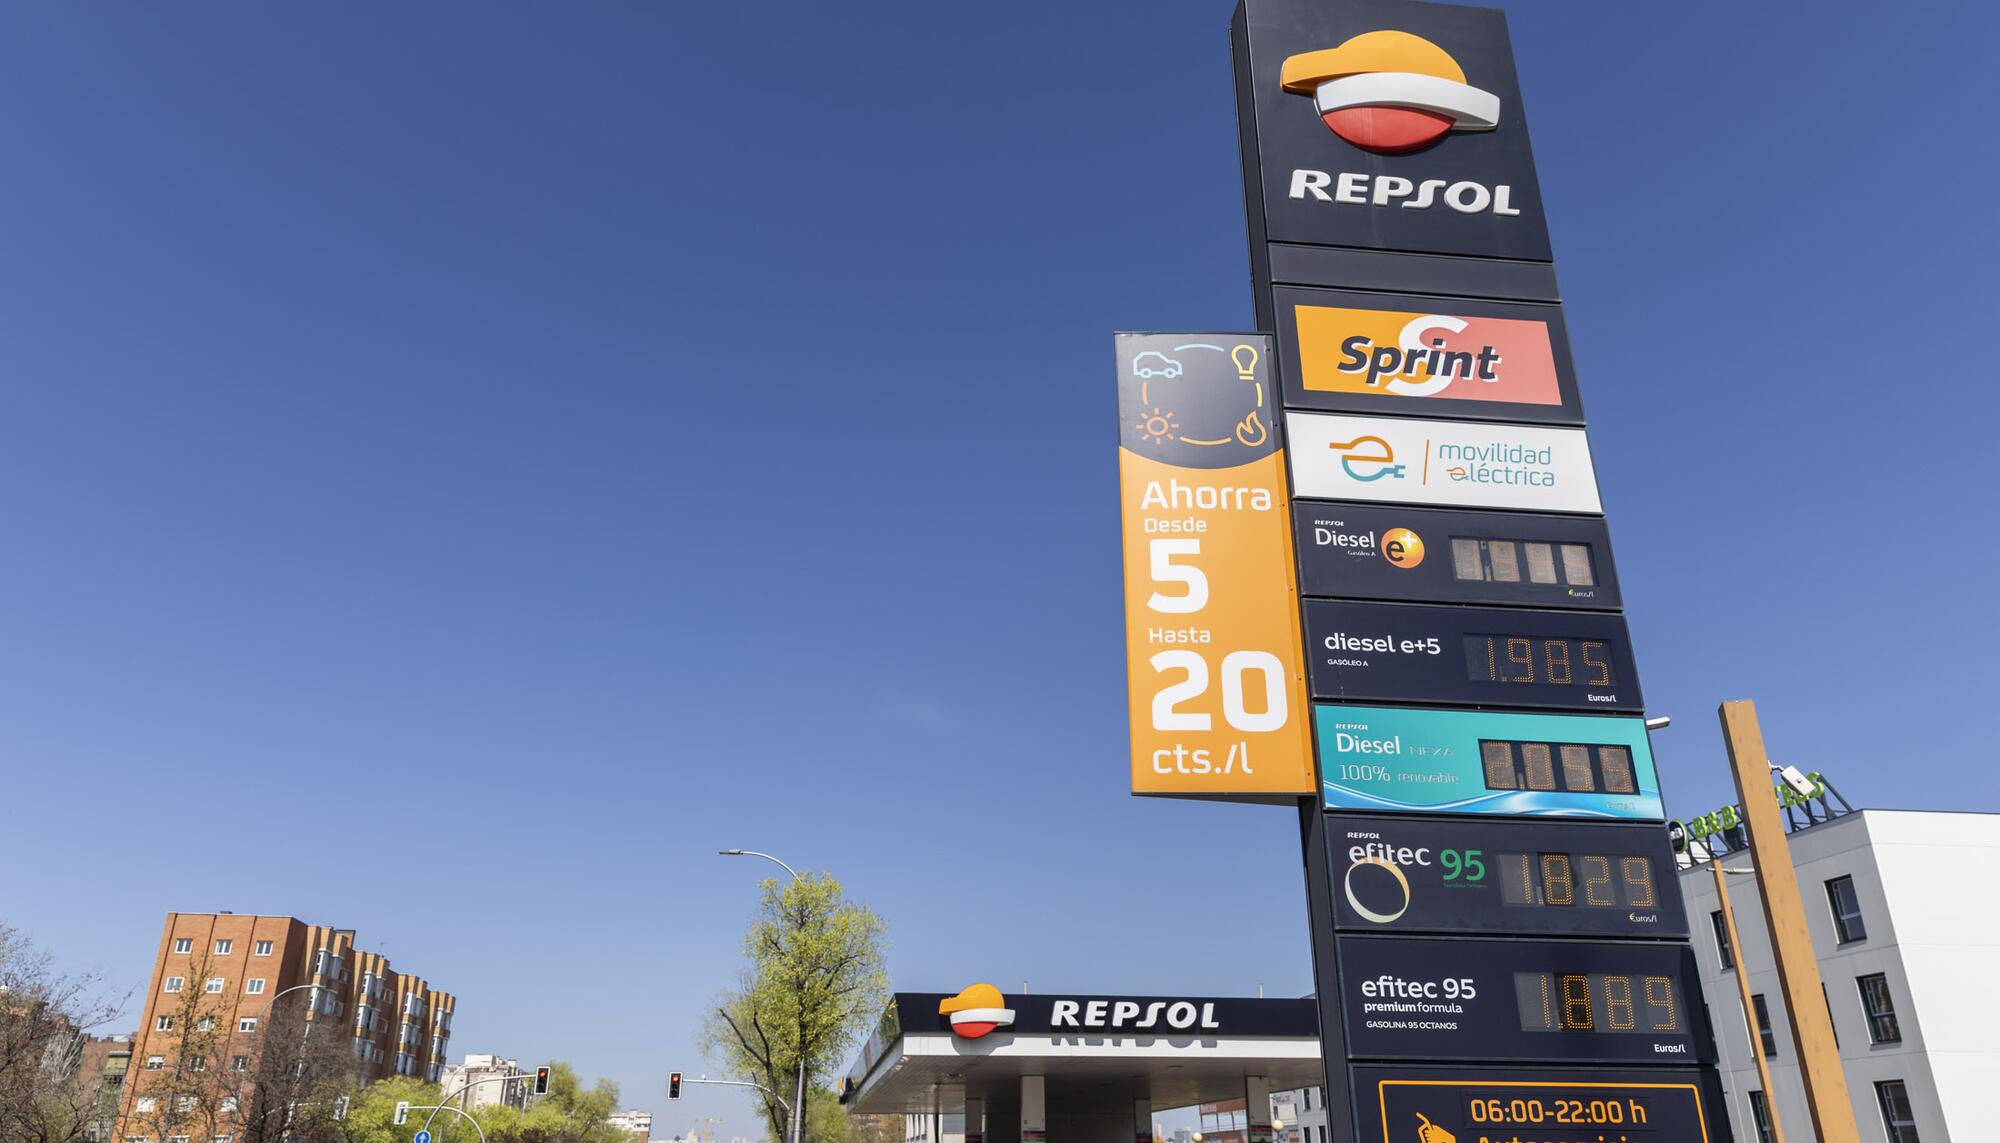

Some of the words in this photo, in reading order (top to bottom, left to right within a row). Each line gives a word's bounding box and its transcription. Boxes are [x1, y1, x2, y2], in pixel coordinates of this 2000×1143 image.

[1289, 169, 1521, 216] REPSOL
[1337, 336, 1502, 387] Sprint
[1439, 443, 1551, 465] movilidad
[1446, 463, 1555, 487] eléctrica
[1140, 478, 1272, 511] Ahorra
[1143, 516, 1207, 533] Desde
[1314, 519, 1344, 527] REPSOL
[1314, 527, 1375, 548] Diesel
[1146, 538, 1209, 614] 5
[1148, 626, 1211, 644] Hasta
[1324, 632, 1397, 653] diesel
[1400, 638, 1441, 655] e+5
[1327, 658, 1362, 667] GASÓLEO
[1149, 649, 1289, 733] 20
[1587, 694, 1617, 703] Euros/l
[1335, 723, 1368, 731] REPSOL
[1336, 732, 1401, 755] Diesel
[1152, 741, 1253, 775] cts./l
[1340, 764, 1391, 783] 100%
[1692, 805, 1737, 840] B&B
[1349, 843, 1432, 867] efitec
[1440, 849, 1486, 881] 95
[1522, 854, 1654, 907] 1.829
[1361, 975, 1438, 999] efitec
[1442, 978, 1477, 1000] 95
[1050, 1000, 1220, 1029] REPSOL
[1541, 975, 1677, 1030] 1.889
[1366, 1020, 1407, 1029] GASOLINA
[1407, 1021, 1418, 1029] 95
[1419, 1021, 1458, 1030] OCTANOS
[1653, 1044, 1686, 1053] Euros/l
[1470, 1099, 1624, 1124] 06:00-22:00
[1629, 1098, 1647, 1124] h
